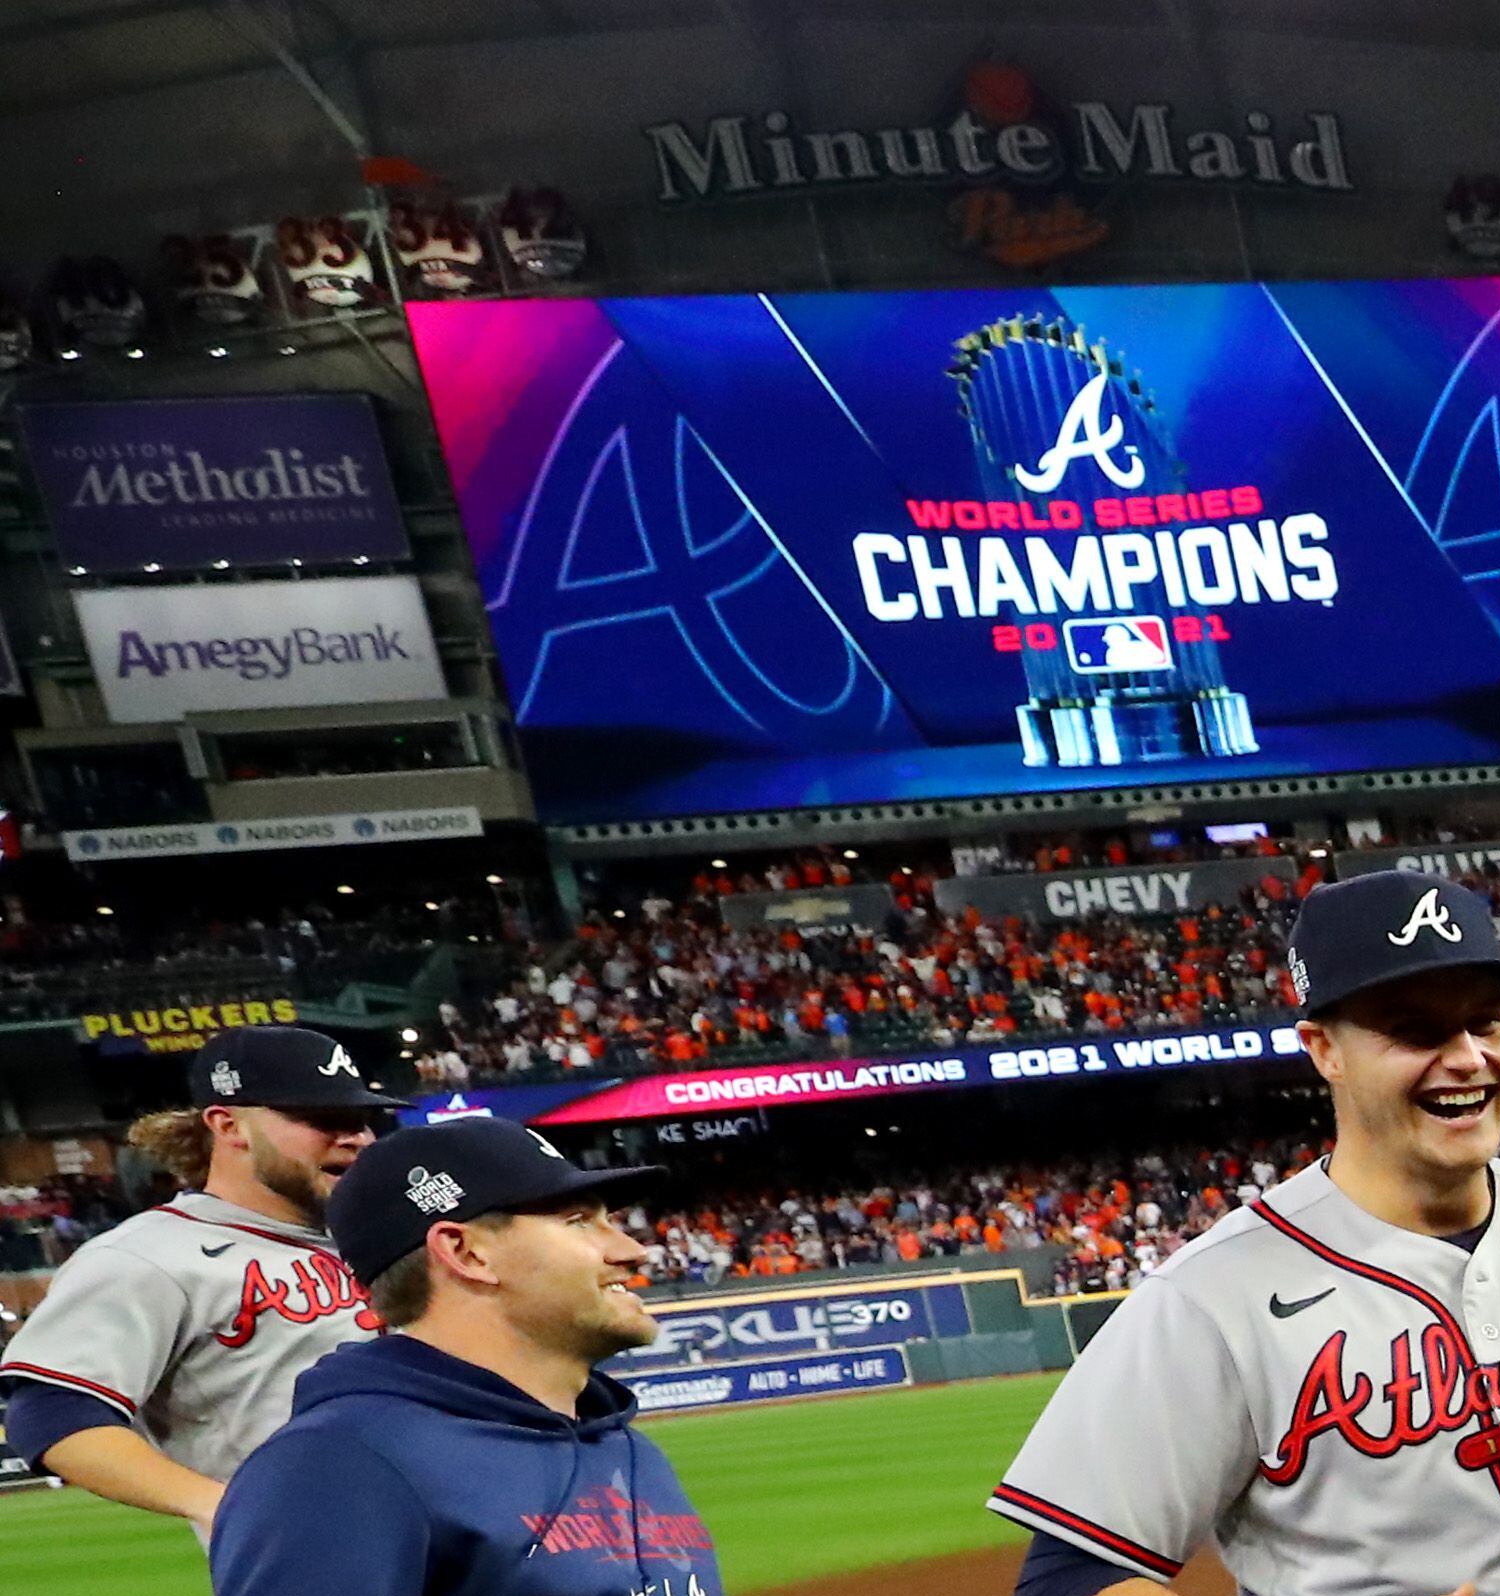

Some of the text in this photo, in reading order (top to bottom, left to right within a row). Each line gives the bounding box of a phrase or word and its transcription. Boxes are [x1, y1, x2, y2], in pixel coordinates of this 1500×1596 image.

[645, 101, 1355, 201] Minute Maid
[53, 441, 177, 461] HOUSTON
[70, 447, 372, 508] Methodist
[905, 486, 1265, 531] WORLD SERIES
[852, 511, 1339, 622] CHAMPIONS
[246, 822, 335, 842] NABORS
[381, 813, 470, 834] NABORS
[107, 831, 199, 852] NABORS
[1044, 871, 1192, 918] CHEVY
[81, 998, 298, 1039] PLUCKERS
[664, 1057, 967, 1106] CONGRATULATIONS
[989, 1045, 1107, 1079] 2021
[1113, 1030, 1263, 1069] WORLD
[406, 1172, 455, 1201] WORLD
[416, 1184, 464, 1215] SERIES
[850, 1300, 912, 1326] 370
[748, 1369, 789, 1391] AUTO
[852, 1359, 887, 1381] LIFE
